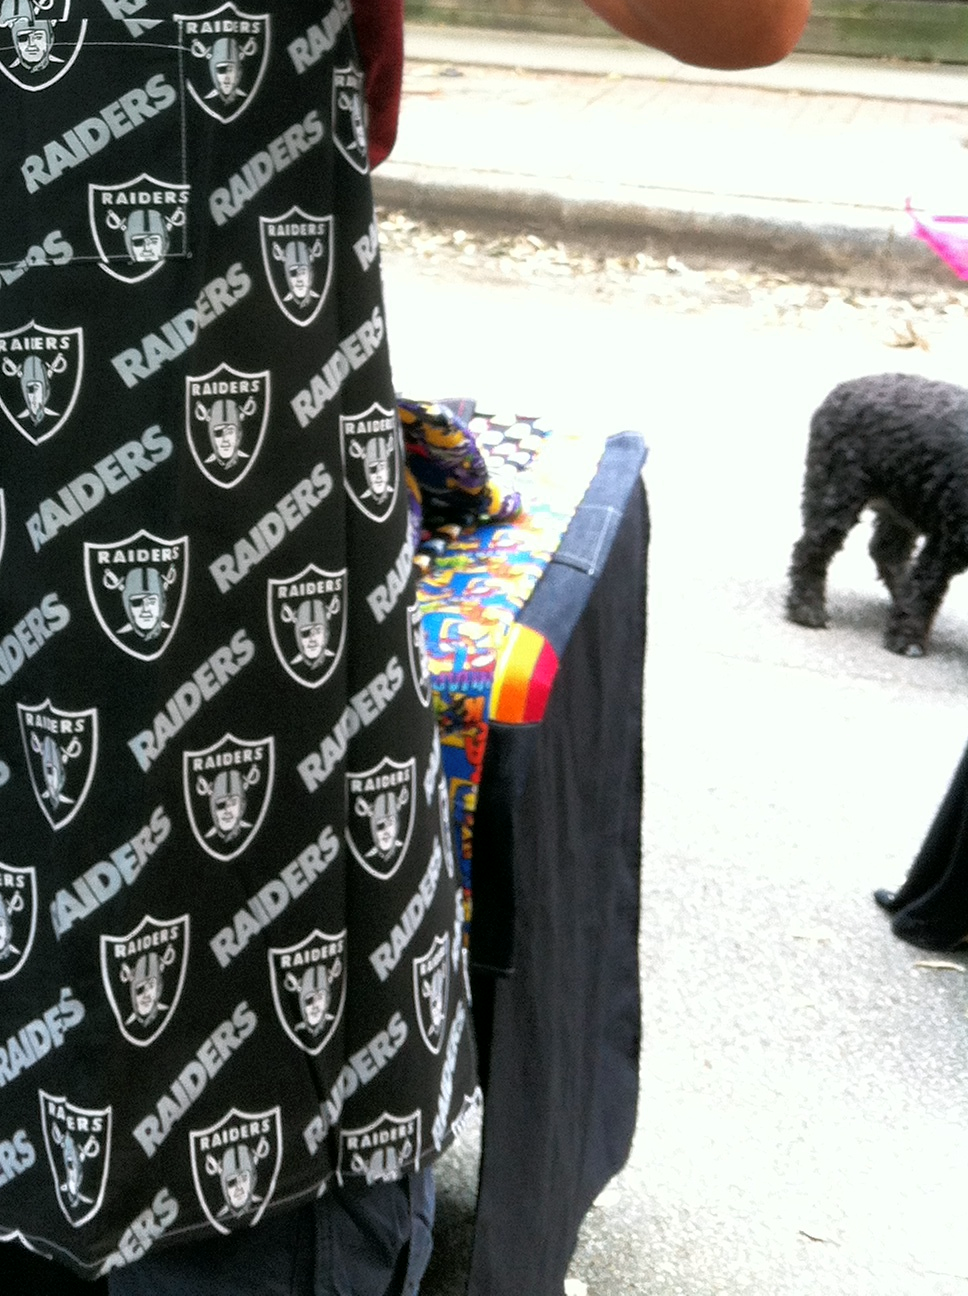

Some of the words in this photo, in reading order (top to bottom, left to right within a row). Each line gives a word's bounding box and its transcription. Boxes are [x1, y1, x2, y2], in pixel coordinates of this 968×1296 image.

[185, 20, 261, 35] RAIDERS
[20, 73, 177, 194] RAIDERS
[208, 110, 325, 227] RAIDERS
[101, 190, 191, 206] RAIDERS
[267, 222, 326, 238] RAIDERS
[110, 262, 252, 390] RAIDERS
[290, 306, 383, 429] RAIDERS
[190, 379, 261, 397] RAIDERS
[24, 424, 174, 554] RAIDERS
[208, 462, 333, 594] RAIDERS
[97, 544, 180, 565] RAIDERS
[277, 578, 343, 599] RAIDERS
[127, 628, 256, 773] RAIDERS
[296, 656, 404, 794] RAIDERS
[192, 747, 263, 772] RAIDERS
[350, 769, 411, 792] RAIDERS
[210, 825, 341, 968] RAIDERS
[114, 925, 180, 959] RAIDERS
[281, 940, 345, 968] RAIDERS
[133, 1001, 258, 1157] RAIDERS
[200, 1120, 272, 1151] RAIDERS
[347, 1121, 415, 1151] RAIDERS
